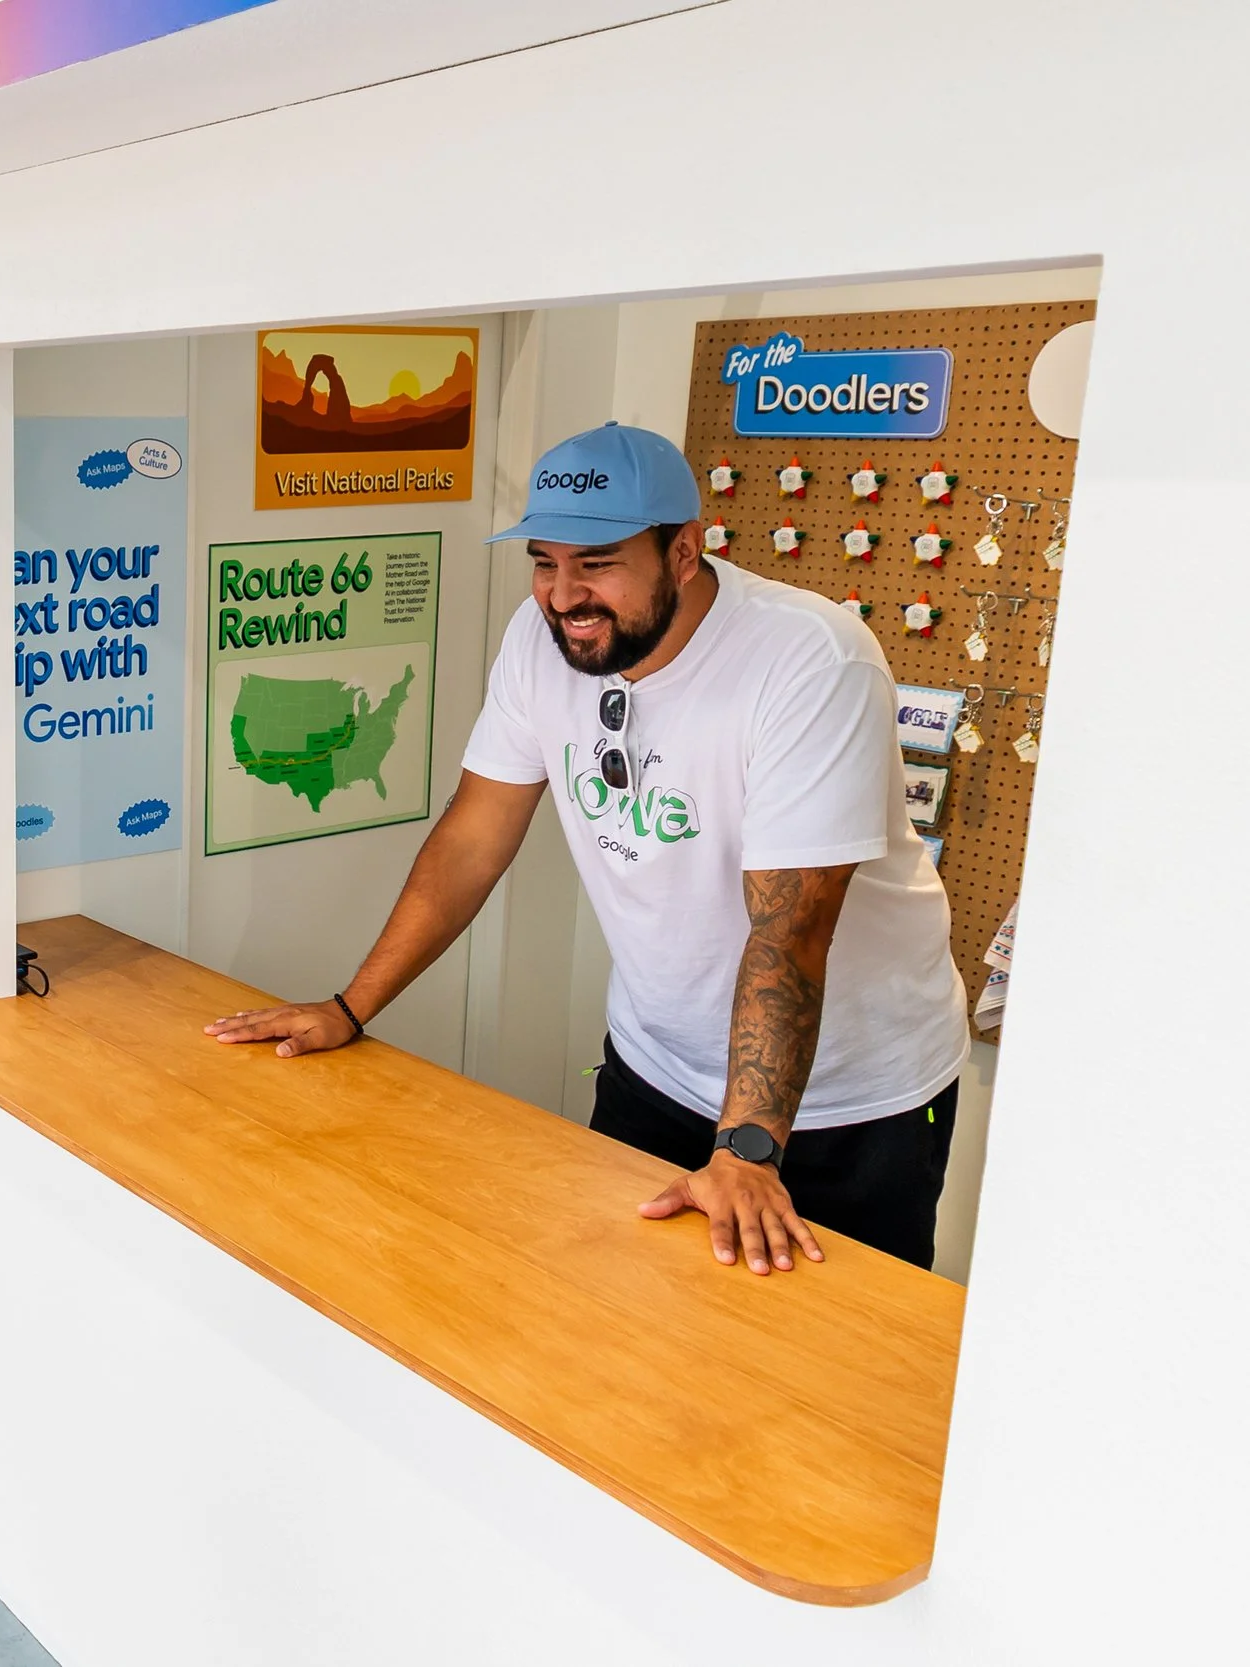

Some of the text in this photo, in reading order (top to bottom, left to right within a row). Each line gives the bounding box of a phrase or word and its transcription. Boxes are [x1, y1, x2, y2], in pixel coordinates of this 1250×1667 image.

[726, 339, 797, 378] For the
[755, 373, 930, 415] Doodlers
[86, 462, 126, 477] Ask Maps
[139, 456, 168, 471] Culture
[142, 446, 167, 459] Arts &
[274, 466, 454, 497] Visit National Parks
[536, 468, 609, 494] Google
[65, 545, 160, 594] your
[219, 550, 373, 602] Route 66
[386, 562, 404, 570] journey
[68, 584, 160, 632] road
[396, 588, 427, 596] collaboration
[219, 598, 348, 650] Rewind
[60, 634, 148, 682] with
[23, 693, 154, 743] Gemini
[565, 742, 700, 843] Iowa
[126, 808, 163, 827] Ask Maps
